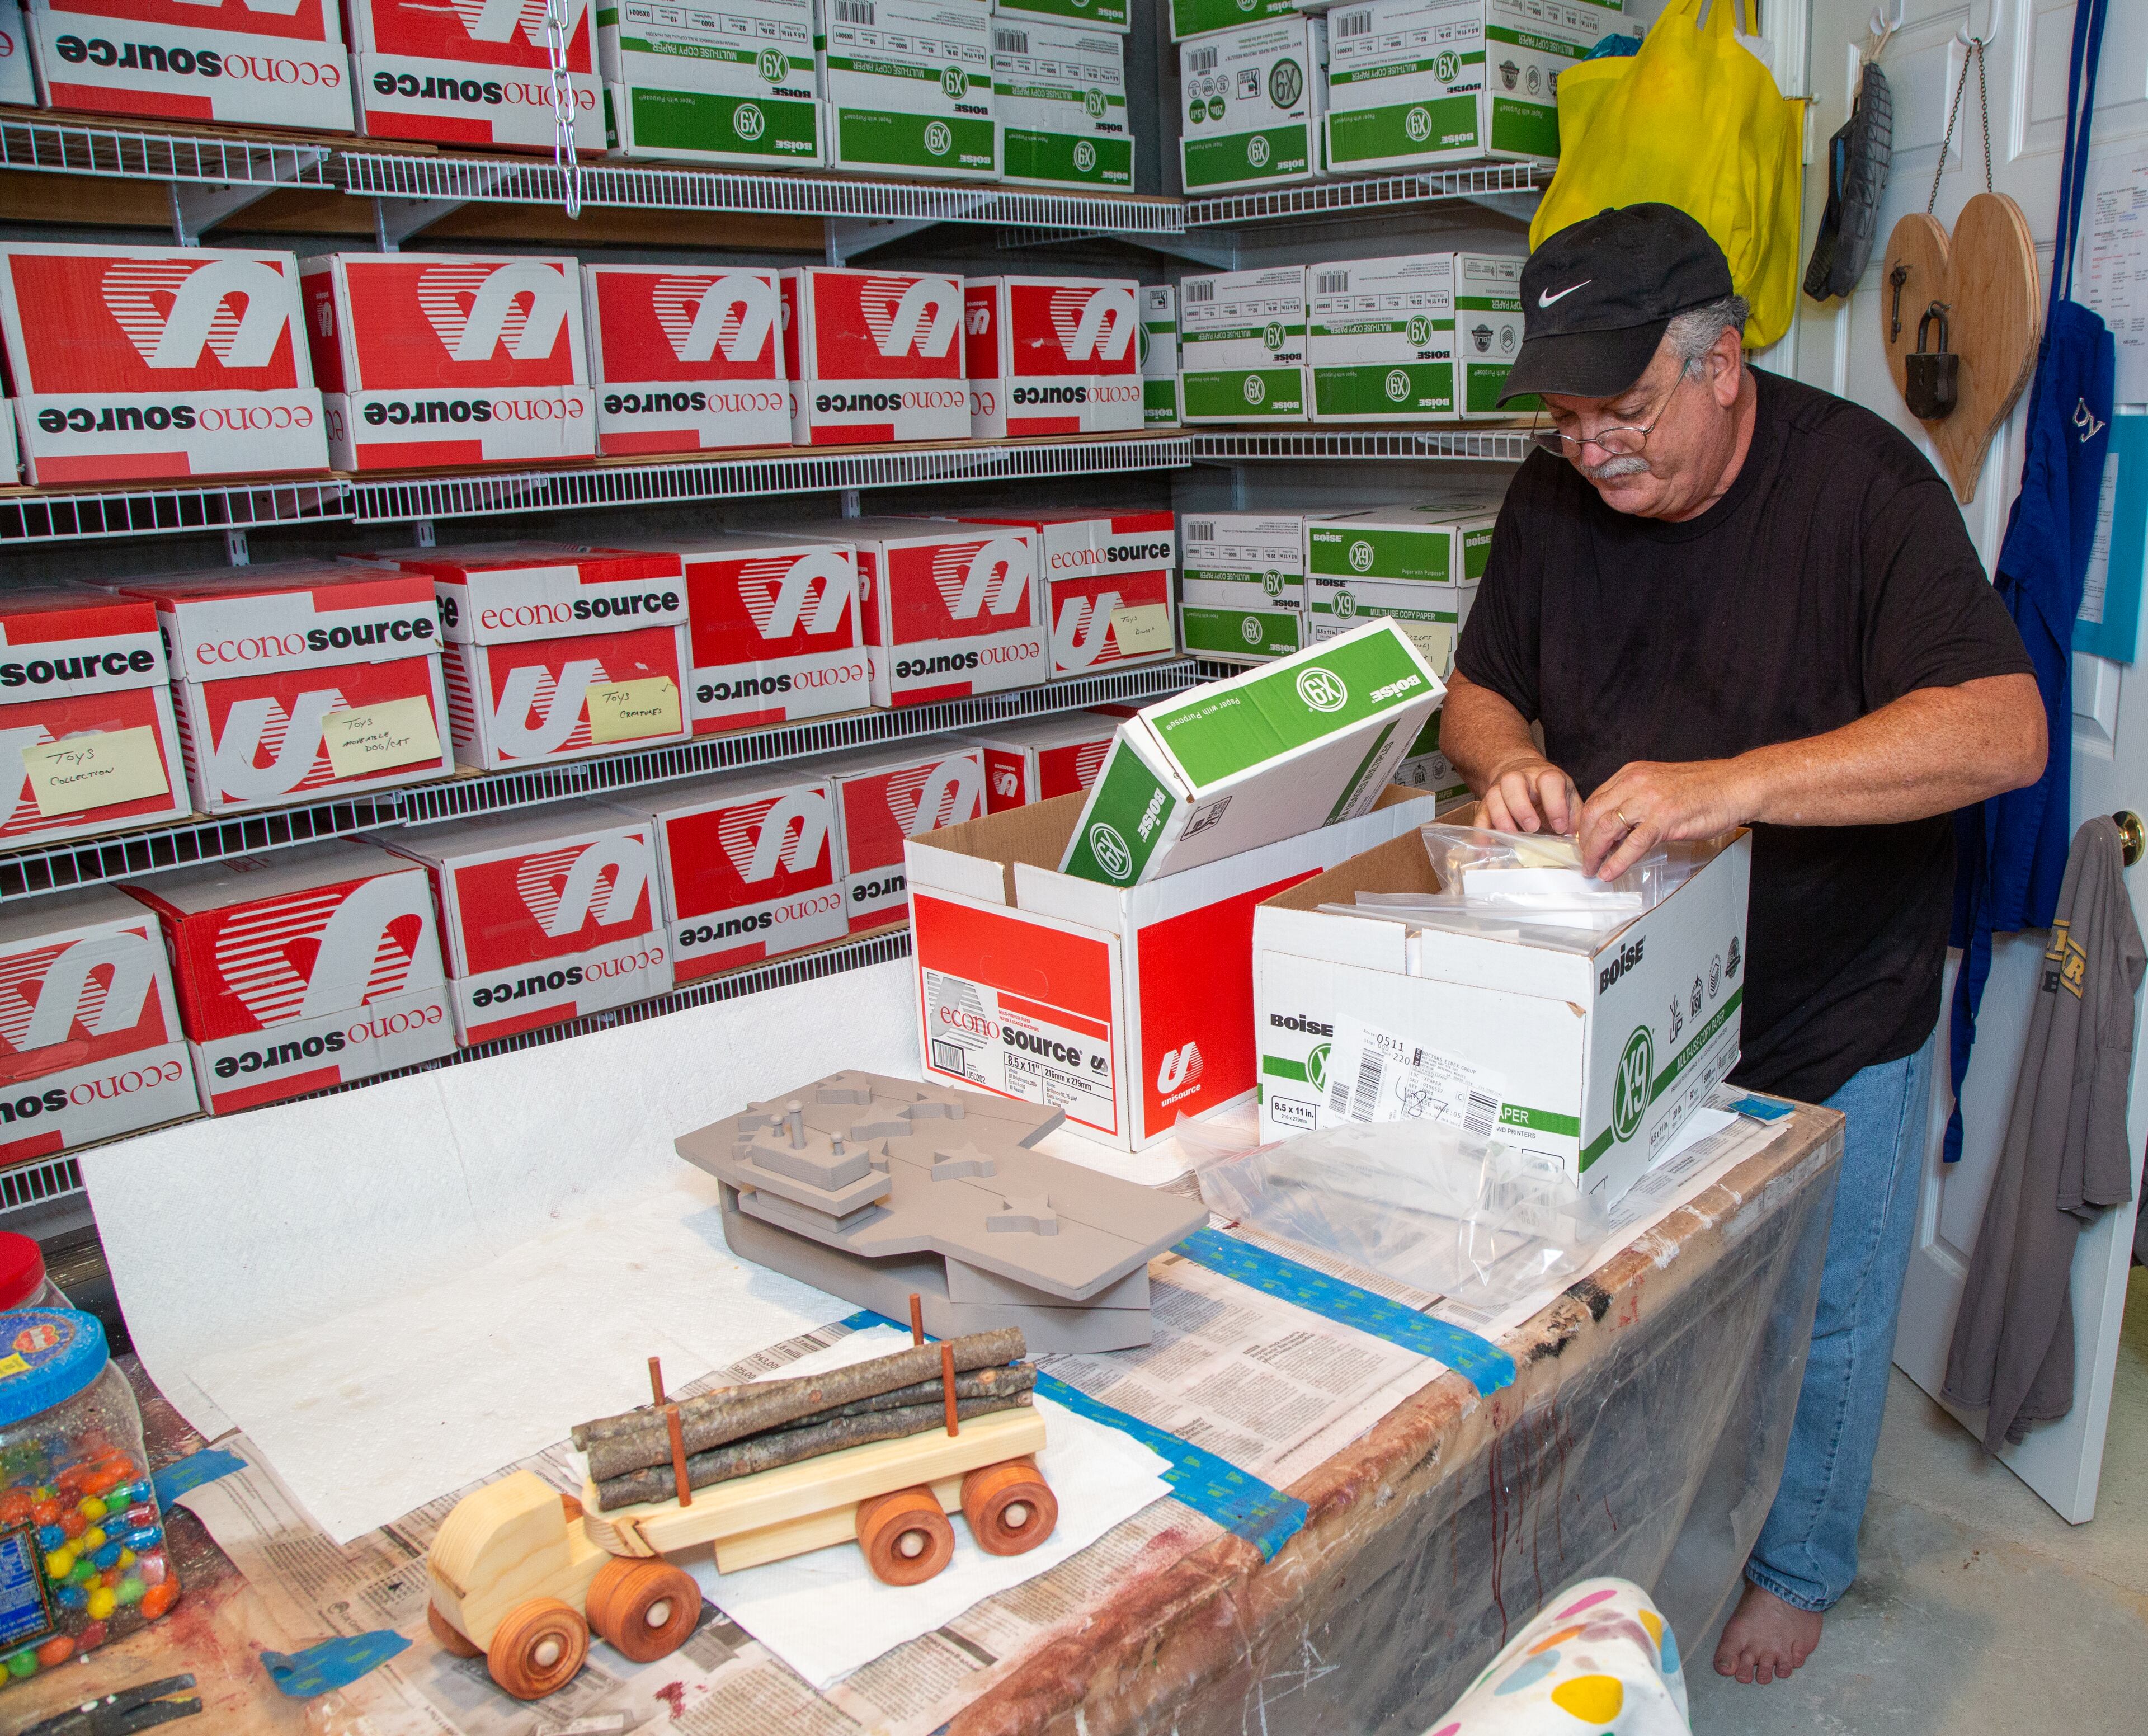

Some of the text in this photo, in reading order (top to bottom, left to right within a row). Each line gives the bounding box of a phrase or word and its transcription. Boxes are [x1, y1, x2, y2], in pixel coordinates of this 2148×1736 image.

[56, 35, 340, 88] econosource
[652, 43, 737, 61] MULTI-USE COPY PAPER
[852, 61, 924, 78] MULTI-USE COPY PAPER
[1351, 63, 1417, 81] MULTI-USE COPY PAPER
[1491, 299, 1509, 309] PAPER
[1364, 323, 1392, 332] MULTI-USE
[604, 392, 783, 415] econosource
[816, 391, 964, 414] econosource
[1014, 385, 1141, 405] econosource
[39, 406, 313, 433] econosource
[364, 397, 583, 426] econosource
[1051, 543, 1170, 570] econosource
[481, 591, 680, 629] econosource
[1370, 609, 1435, 620] MULTI-USE COPY PAPER
[196, 618, 434, 665] econosource
[0, 650, 154, 687] source
[896, 642, 1039, 679] econosource
[696, 665, 864, 702] econosource
[1200, 706, 1220, 720] with
[1221, 697, 1241, 714] Paper
[680, 893, 841, 947] econosource
[473, 947, 665, 1008] econosource
[998, 1010, 1020, 1020] MULTI-PURPOSE
[1691, 995, 1701, 1018] USA
[940, 1006, 1000, 1039] econo
[1024, 1023, 1039, 1032] MULTIPLES
[215, 1005, 442, 1078] econosource
[1377, 1034, 1403, 1052] 0511
[1378, 1043, 1389, 1052] 000
[1008, 1055, 1019, 1067] 8.5
[1393, 1052, 1410, 1065] 220
[1422, 1051, 1476, 1074] DOCTORS EIDEX GROUP
[967, 1070, 986, 1084] U50202
[1045, 1069, 1065, 1082] 216mm
[1071, 1078, 1091, 1091] 279mm
[1047, 1087, 1061, 1096] Brillance
[1161, 1083, 1202, 1108] unisource
[1274, 1101, 1288, 1113] 8.5
[1297, 1105, 1303, 1116] 11
[1507, 1128, 1536, 1139] PRINTERS
